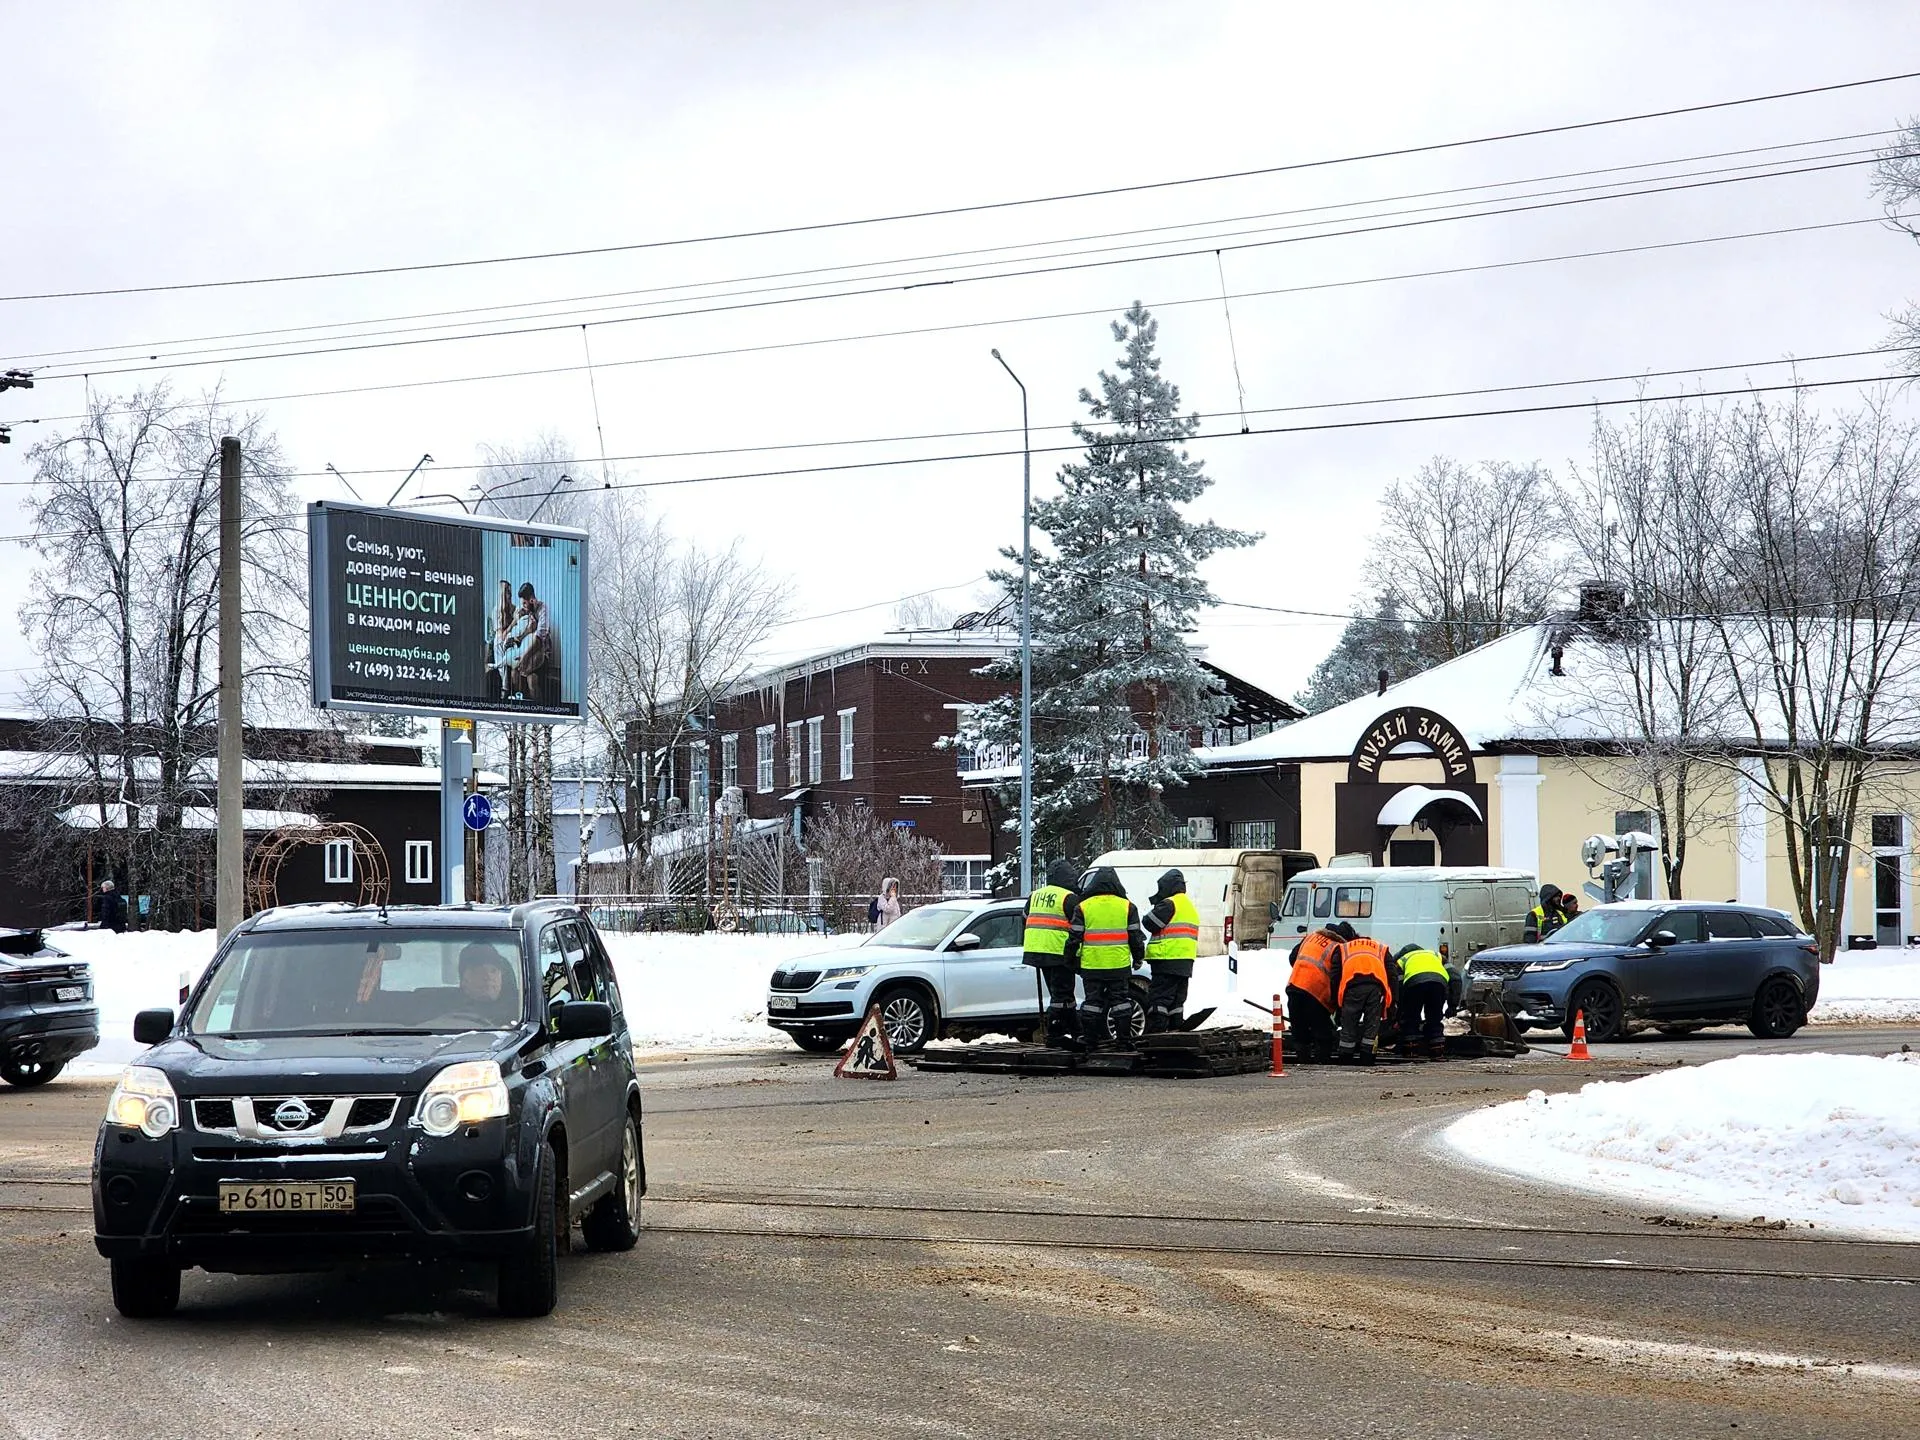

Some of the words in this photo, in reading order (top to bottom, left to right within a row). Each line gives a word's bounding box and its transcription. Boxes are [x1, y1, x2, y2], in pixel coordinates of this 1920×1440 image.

[346, 534, 394, 559] Семья,
[396, 545, 426, 563] уют,
[346, 561, 407, 580] доверие
[424, 570, 474, 586] вечные
[346, 582, 456, 615] ЦЕННОСТИ
[347, 613, 355, 625] в
[359, 613, 412, 631] каждом
[416, 619, 451, 635] доме
[348, 643, 451, 664] ценностьдубна.рф
[347, 661, 362, 674] +7
[364, 662, 394, 680] (499)
[396, 665, 451, 682] 322-24-24
[1357, 713, 1408, 773] МУЗЕЙ
[1418, 717, 1468, 776] ЗАМКА
[324, 1186, 347, 1202] 50
